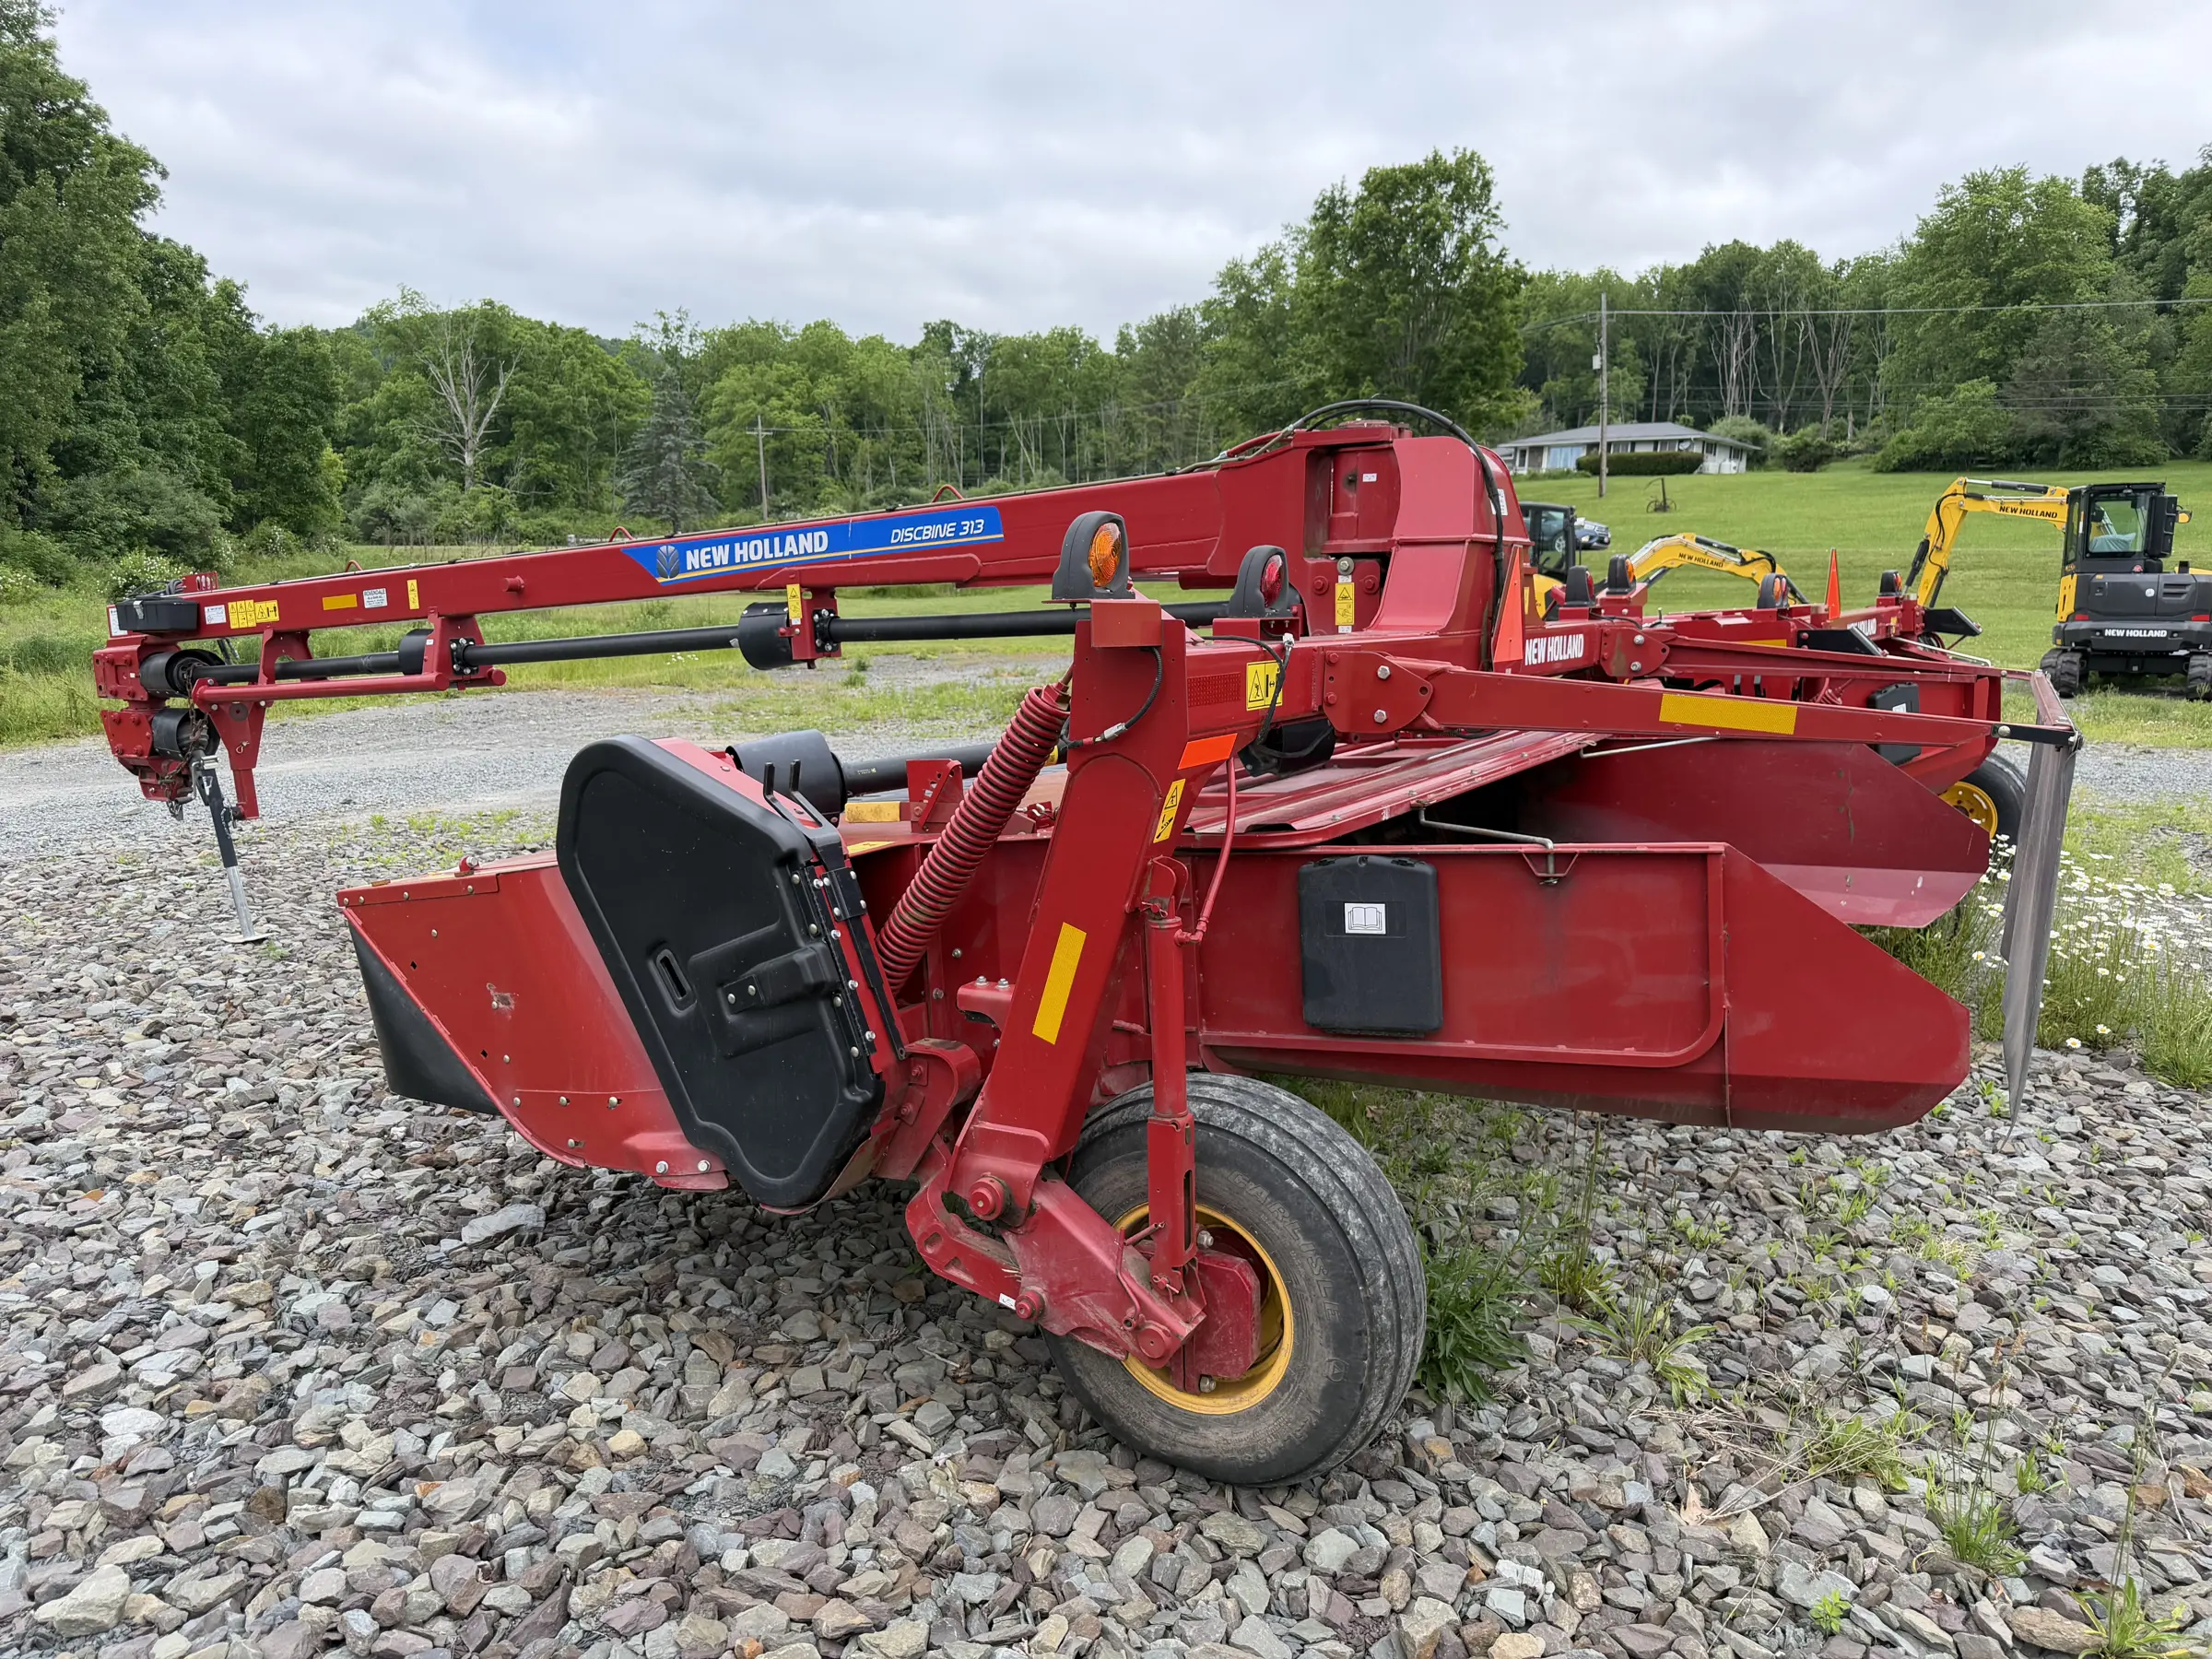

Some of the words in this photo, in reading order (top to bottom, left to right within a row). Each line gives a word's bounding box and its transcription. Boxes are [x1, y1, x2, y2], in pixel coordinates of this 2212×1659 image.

[1999, 505, 2018, 513] NEW
[2019, 508, 2058, 519] HOLLAND
[890, 522, 957, 544] DISCBINE
[959, 519, 984, 535] 313
[686, 544, 730, 571] NEW
[734, 530, 829, 563] HOLLAND
[1678, 552, 1694, 560] NEW
[1694, 556, 1724, 568] HOLLAND
[2104, 629, 2125, 637] NEW
[2125, 629, 2168, 638] HOLLAND
[1524, 637, 1547, 666] NEW
[1547, 633, 1584, 663] HOLLAND
[1228, 1169, 1341, 1321] CARLISLE
